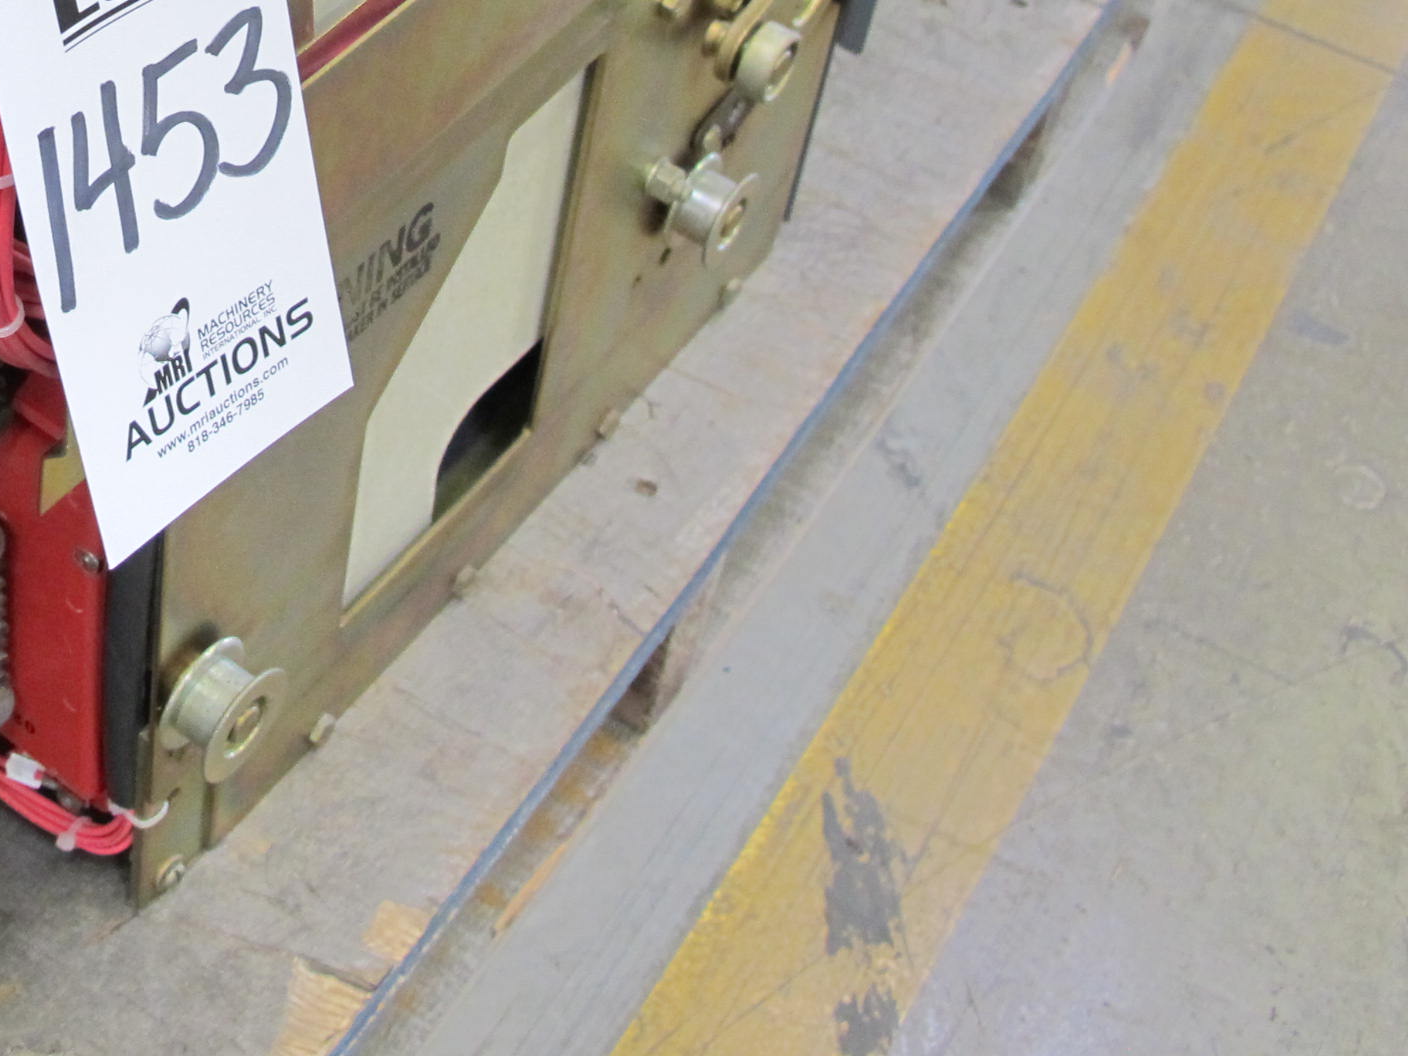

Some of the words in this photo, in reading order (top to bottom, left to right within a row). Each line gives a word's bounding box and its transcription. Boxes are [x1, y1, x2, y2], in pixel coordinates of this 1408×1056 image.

[37, 6, 294, 313] 1453
[197, 279, 273, 341] MACHINERY
[200, 292, 276, 353] RESOURCES
[202, 318, 261, 361] INTERNATIONAL
[126, 297, 313, 462] AUCTIONS
[154, 348, 193, 396] MRI
[156, 356, 289, 459] www.mriauctions.com
[186, 388, 266, 453] 818-346-7985
